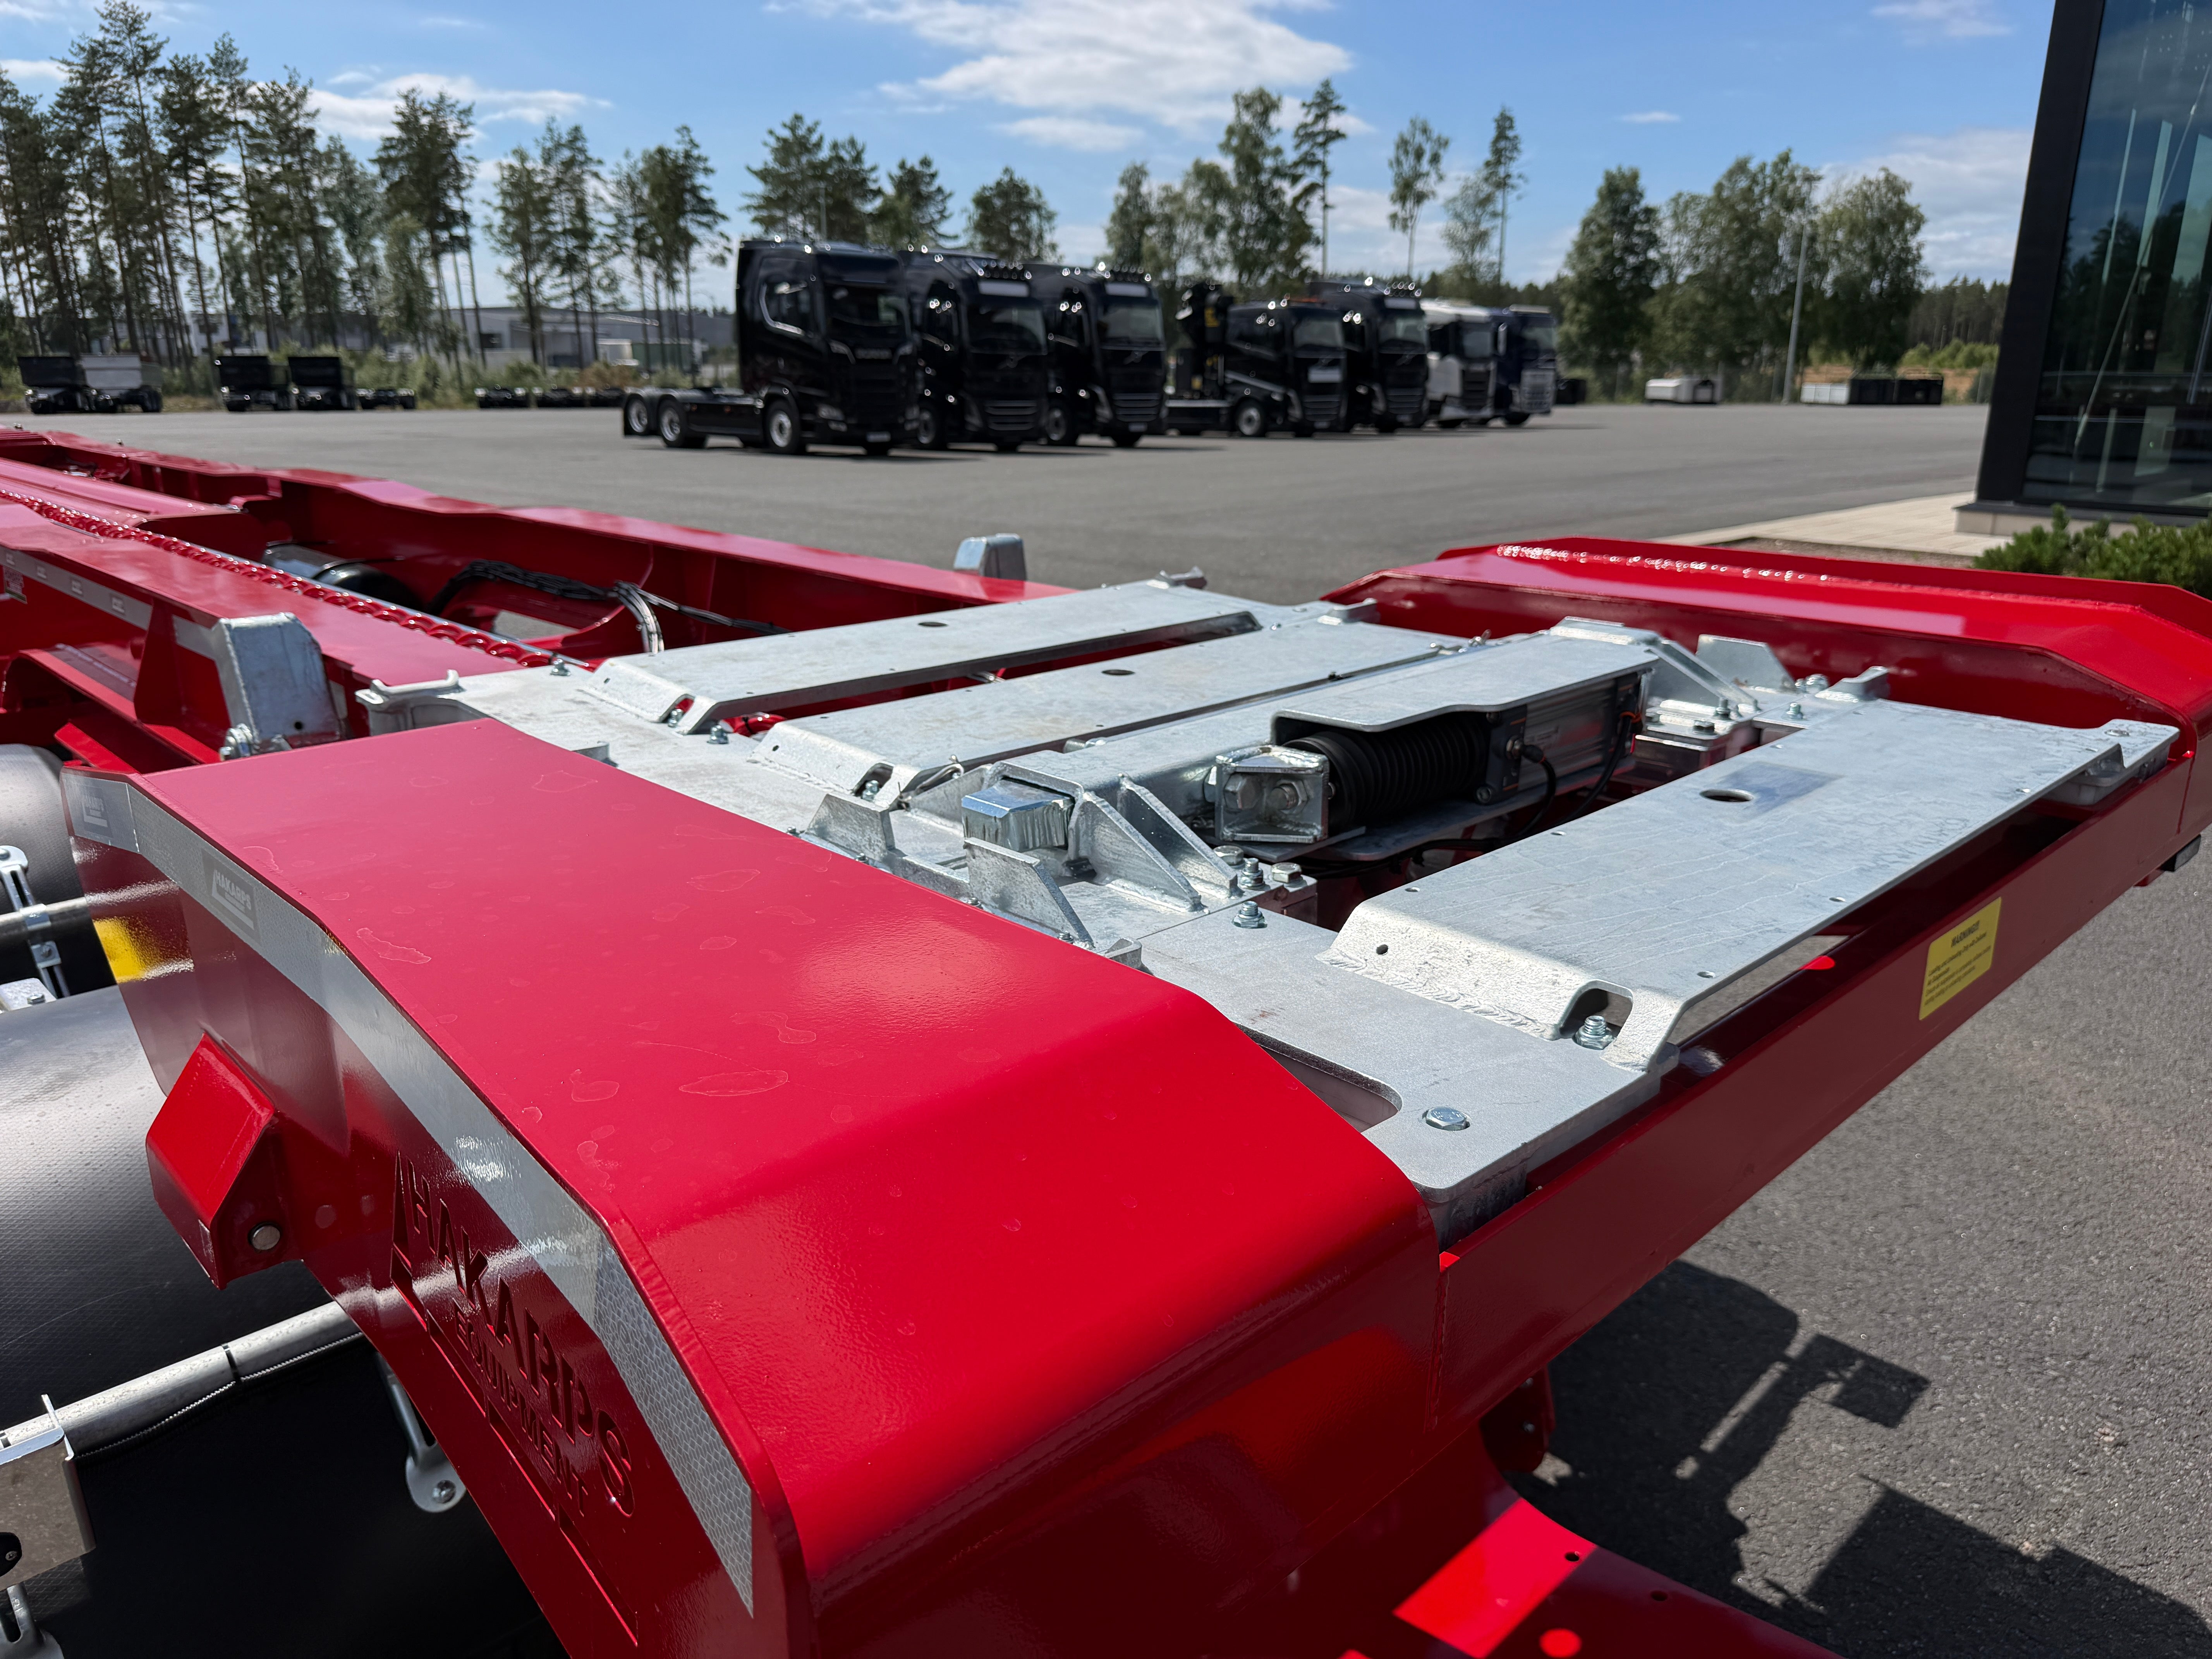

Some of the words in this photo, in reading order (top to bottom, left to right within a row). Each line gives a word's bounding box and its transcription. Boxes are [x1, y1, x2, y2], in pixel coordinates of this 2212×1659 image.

[215, 870, 252, 910] HAKARPS
[407, 1156, 635, 1518] HAKARPS
[453, 1297, 589, 1518] EQUIPMENT
